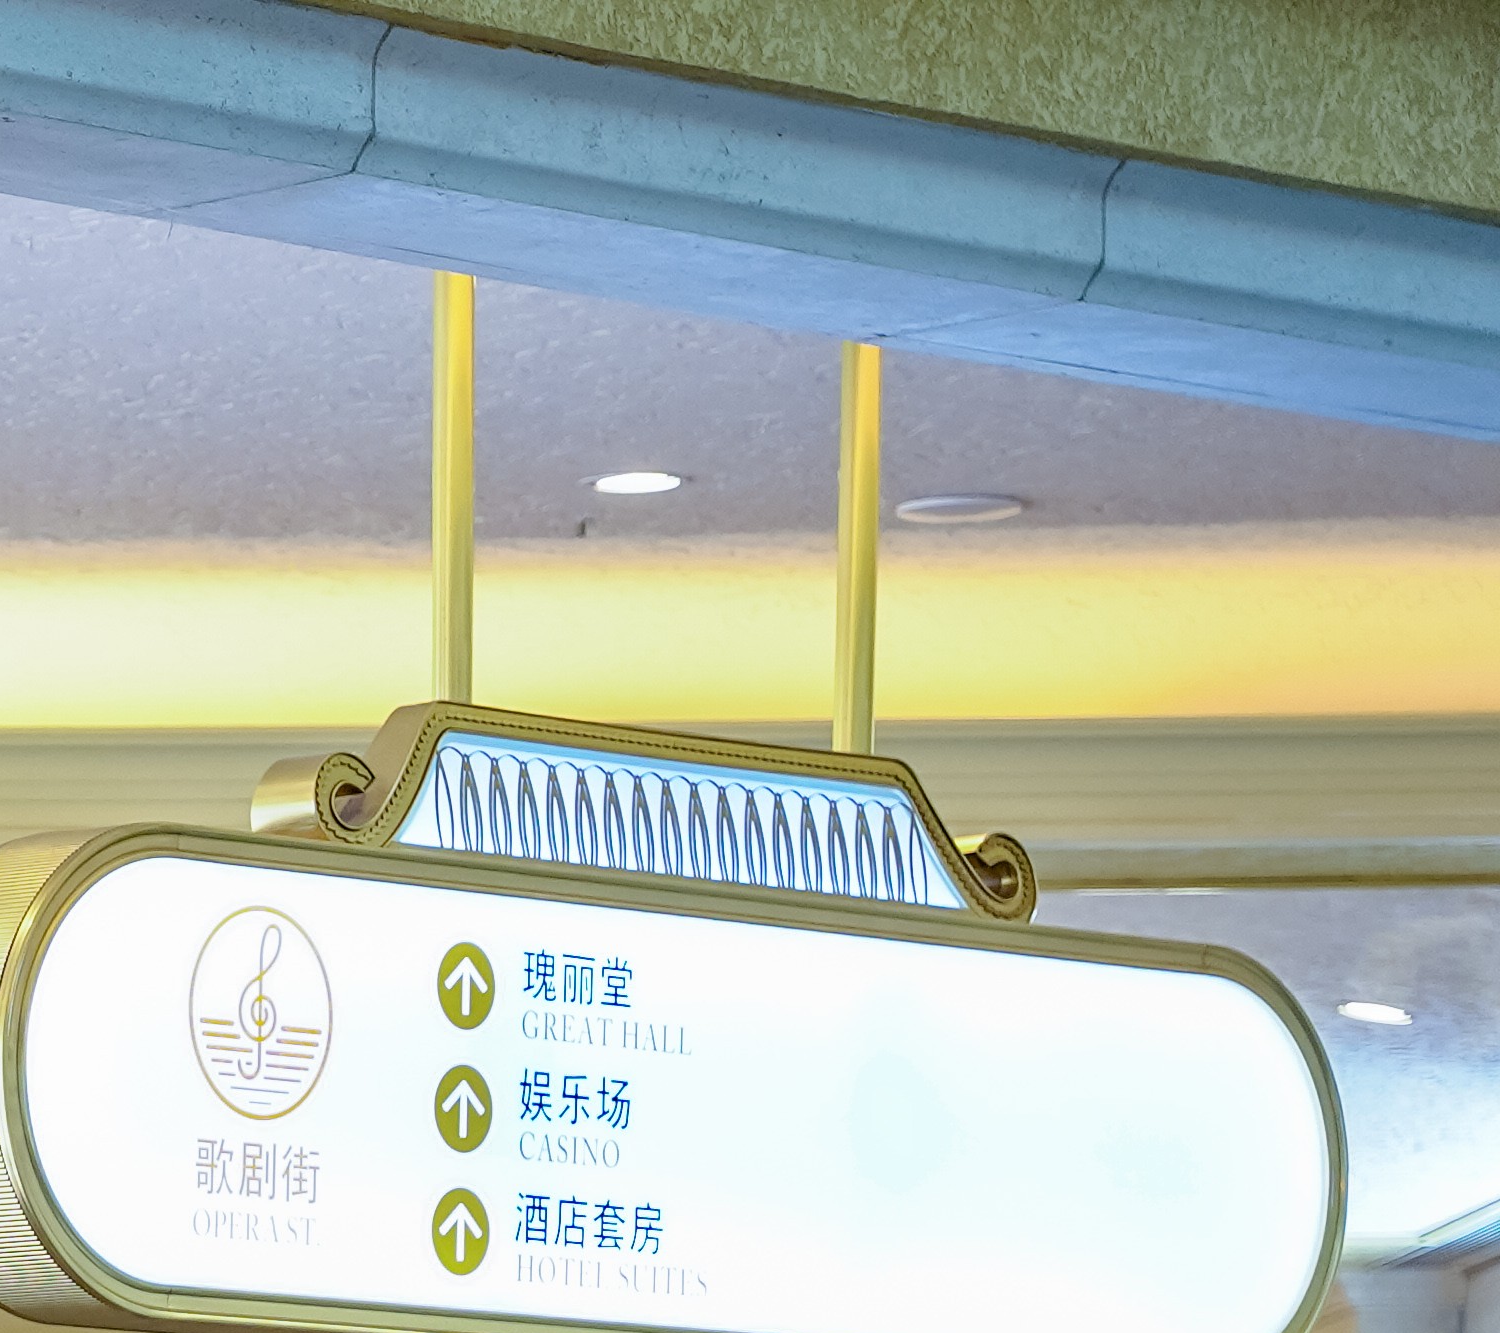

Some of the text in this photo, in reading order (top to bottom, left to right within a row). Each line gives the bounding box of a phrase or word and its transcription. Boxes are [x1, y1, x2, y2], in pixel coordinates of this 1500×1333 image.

[522, 948, 633, 1009] 瑰丽堂
[521, 1009, 693, 1056] GREAT HALL
[519, 1067, 631, 1130] 娱乐场
[195, 1138, 321, 1205] 歌剧街
[518, 1131, 620, 1168] CASINO
[514, 1192, 664, 1255] 酒店套房
